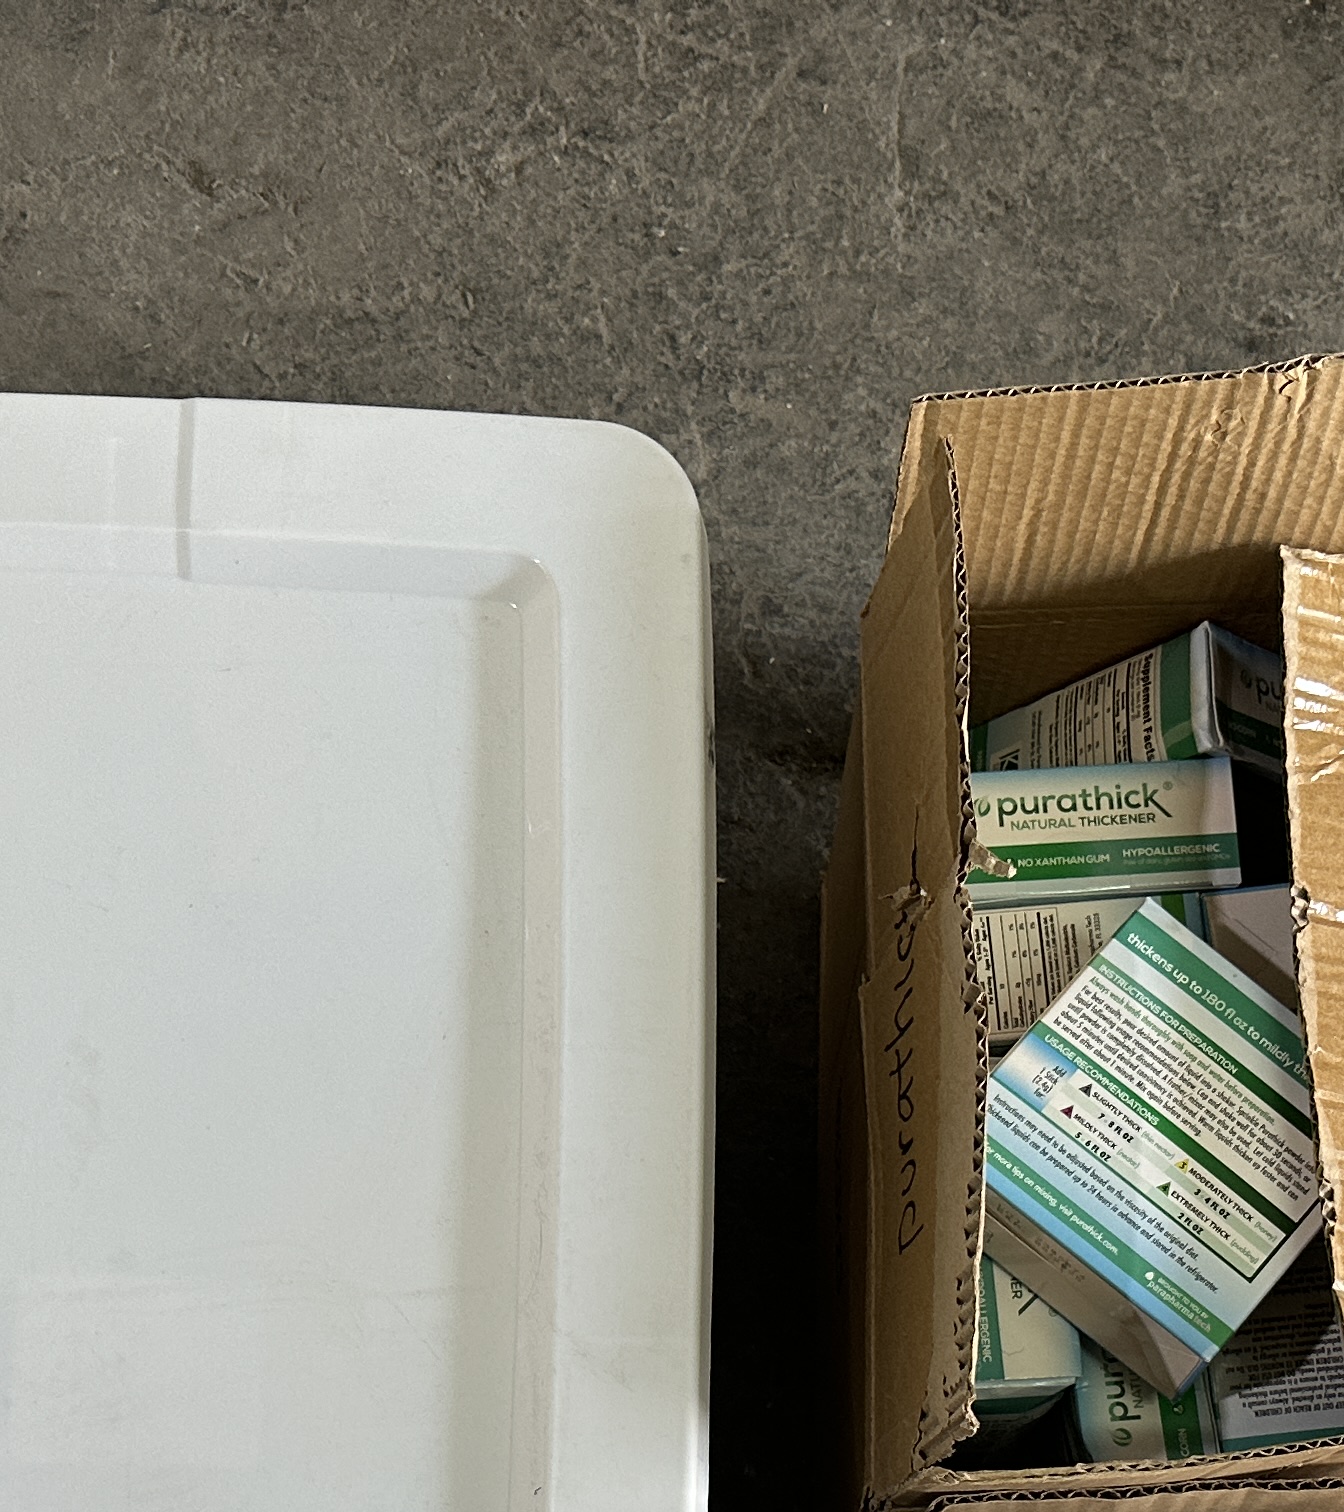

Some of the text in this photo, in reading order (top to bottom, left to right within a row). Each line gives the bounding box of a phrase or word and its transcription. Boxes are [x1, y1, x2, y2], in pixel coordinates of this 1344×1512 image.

[996, 779, 1172, 829] purathick
[1010, 812, 1155, 832] NATURAL THICKENER
[1017, 858, 1034, 868] NO
[1034, 854, 1085, 867] XANTHAN
[1086, 853, 1110, 864] GUM
[1122, 842, 1220, 859] HYPOALLERGENIC
[1097, 963, 1239, 1074] INSTRUCTIONS FOR PREPARATION
[1125, 931, 1296, 1070] thickens up to 180 fl oz to mildly
[1043, 1033, 1160, 1126] USAGE RECOMMENDATIONS
[1072, 1113, 1117, 1150] MILDLY THICK
[1090, 1090, 1142, 1133] SLIGHTLY THICK
[1169, 1190, 1231, 1241] EXTREMELY THICK
[1186, 1167, 1254, 1222] MODERATELY THICK
[1191, 1223, 1203, 1235] OZ
[1146, 1278, 1212, 1333] parapharma tech
